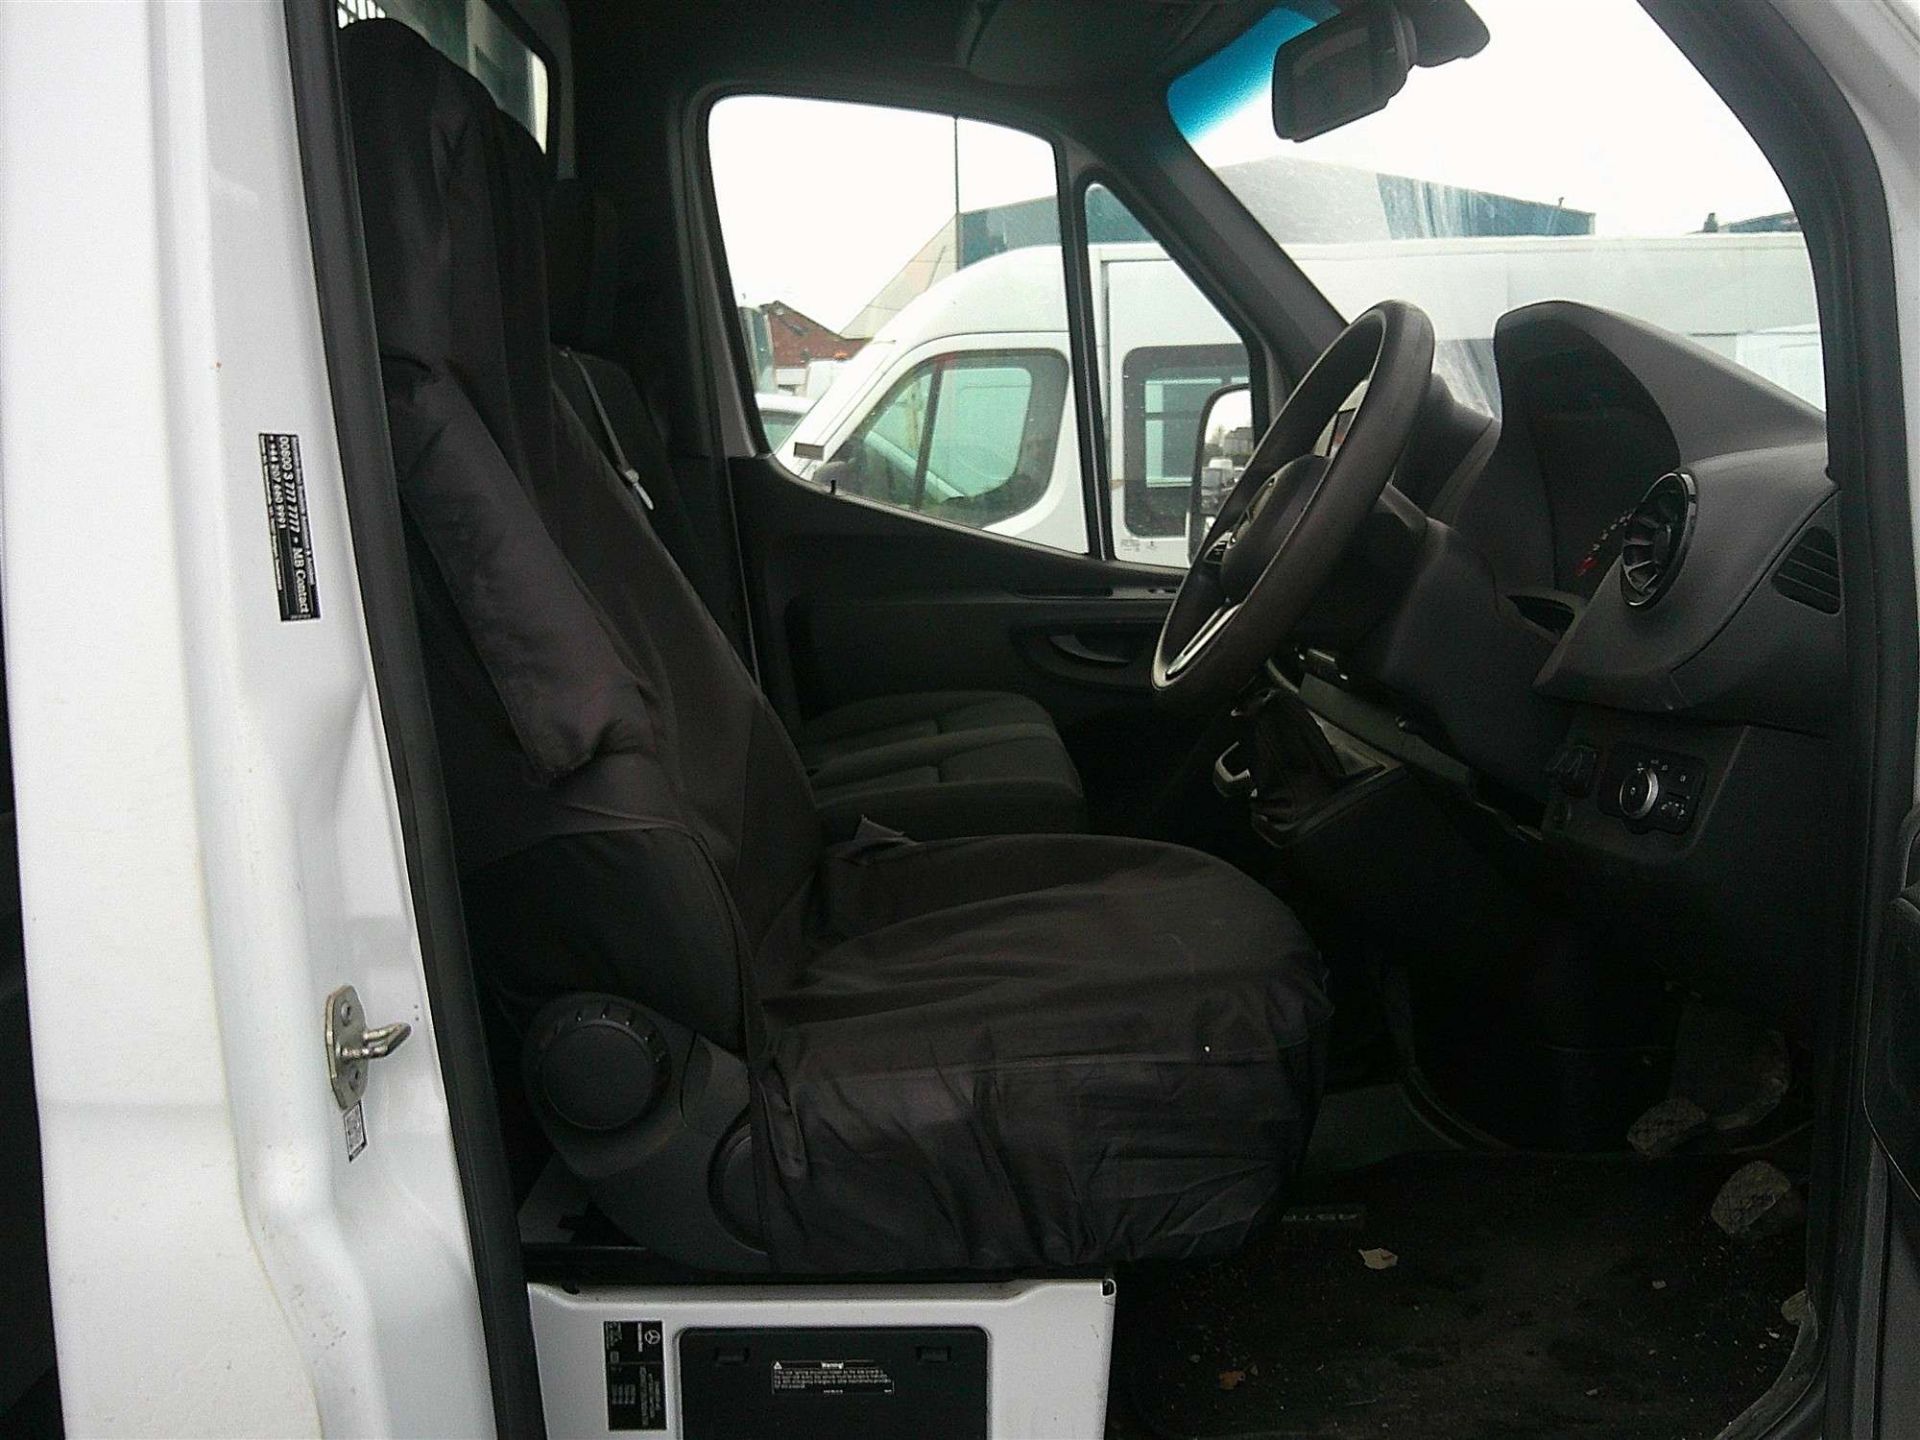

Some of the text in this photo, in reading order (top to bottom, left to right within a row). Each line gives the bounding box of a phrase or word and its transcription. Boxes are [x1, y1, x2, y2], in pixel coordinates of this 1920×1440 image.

[279, 436, 293, 470] 00800
[284, 482, 297, 503] 777
[288, 504, 301, 533] 7777
[293, 547, 305, 568] MB
[296, 570, 309, 613] Contact
